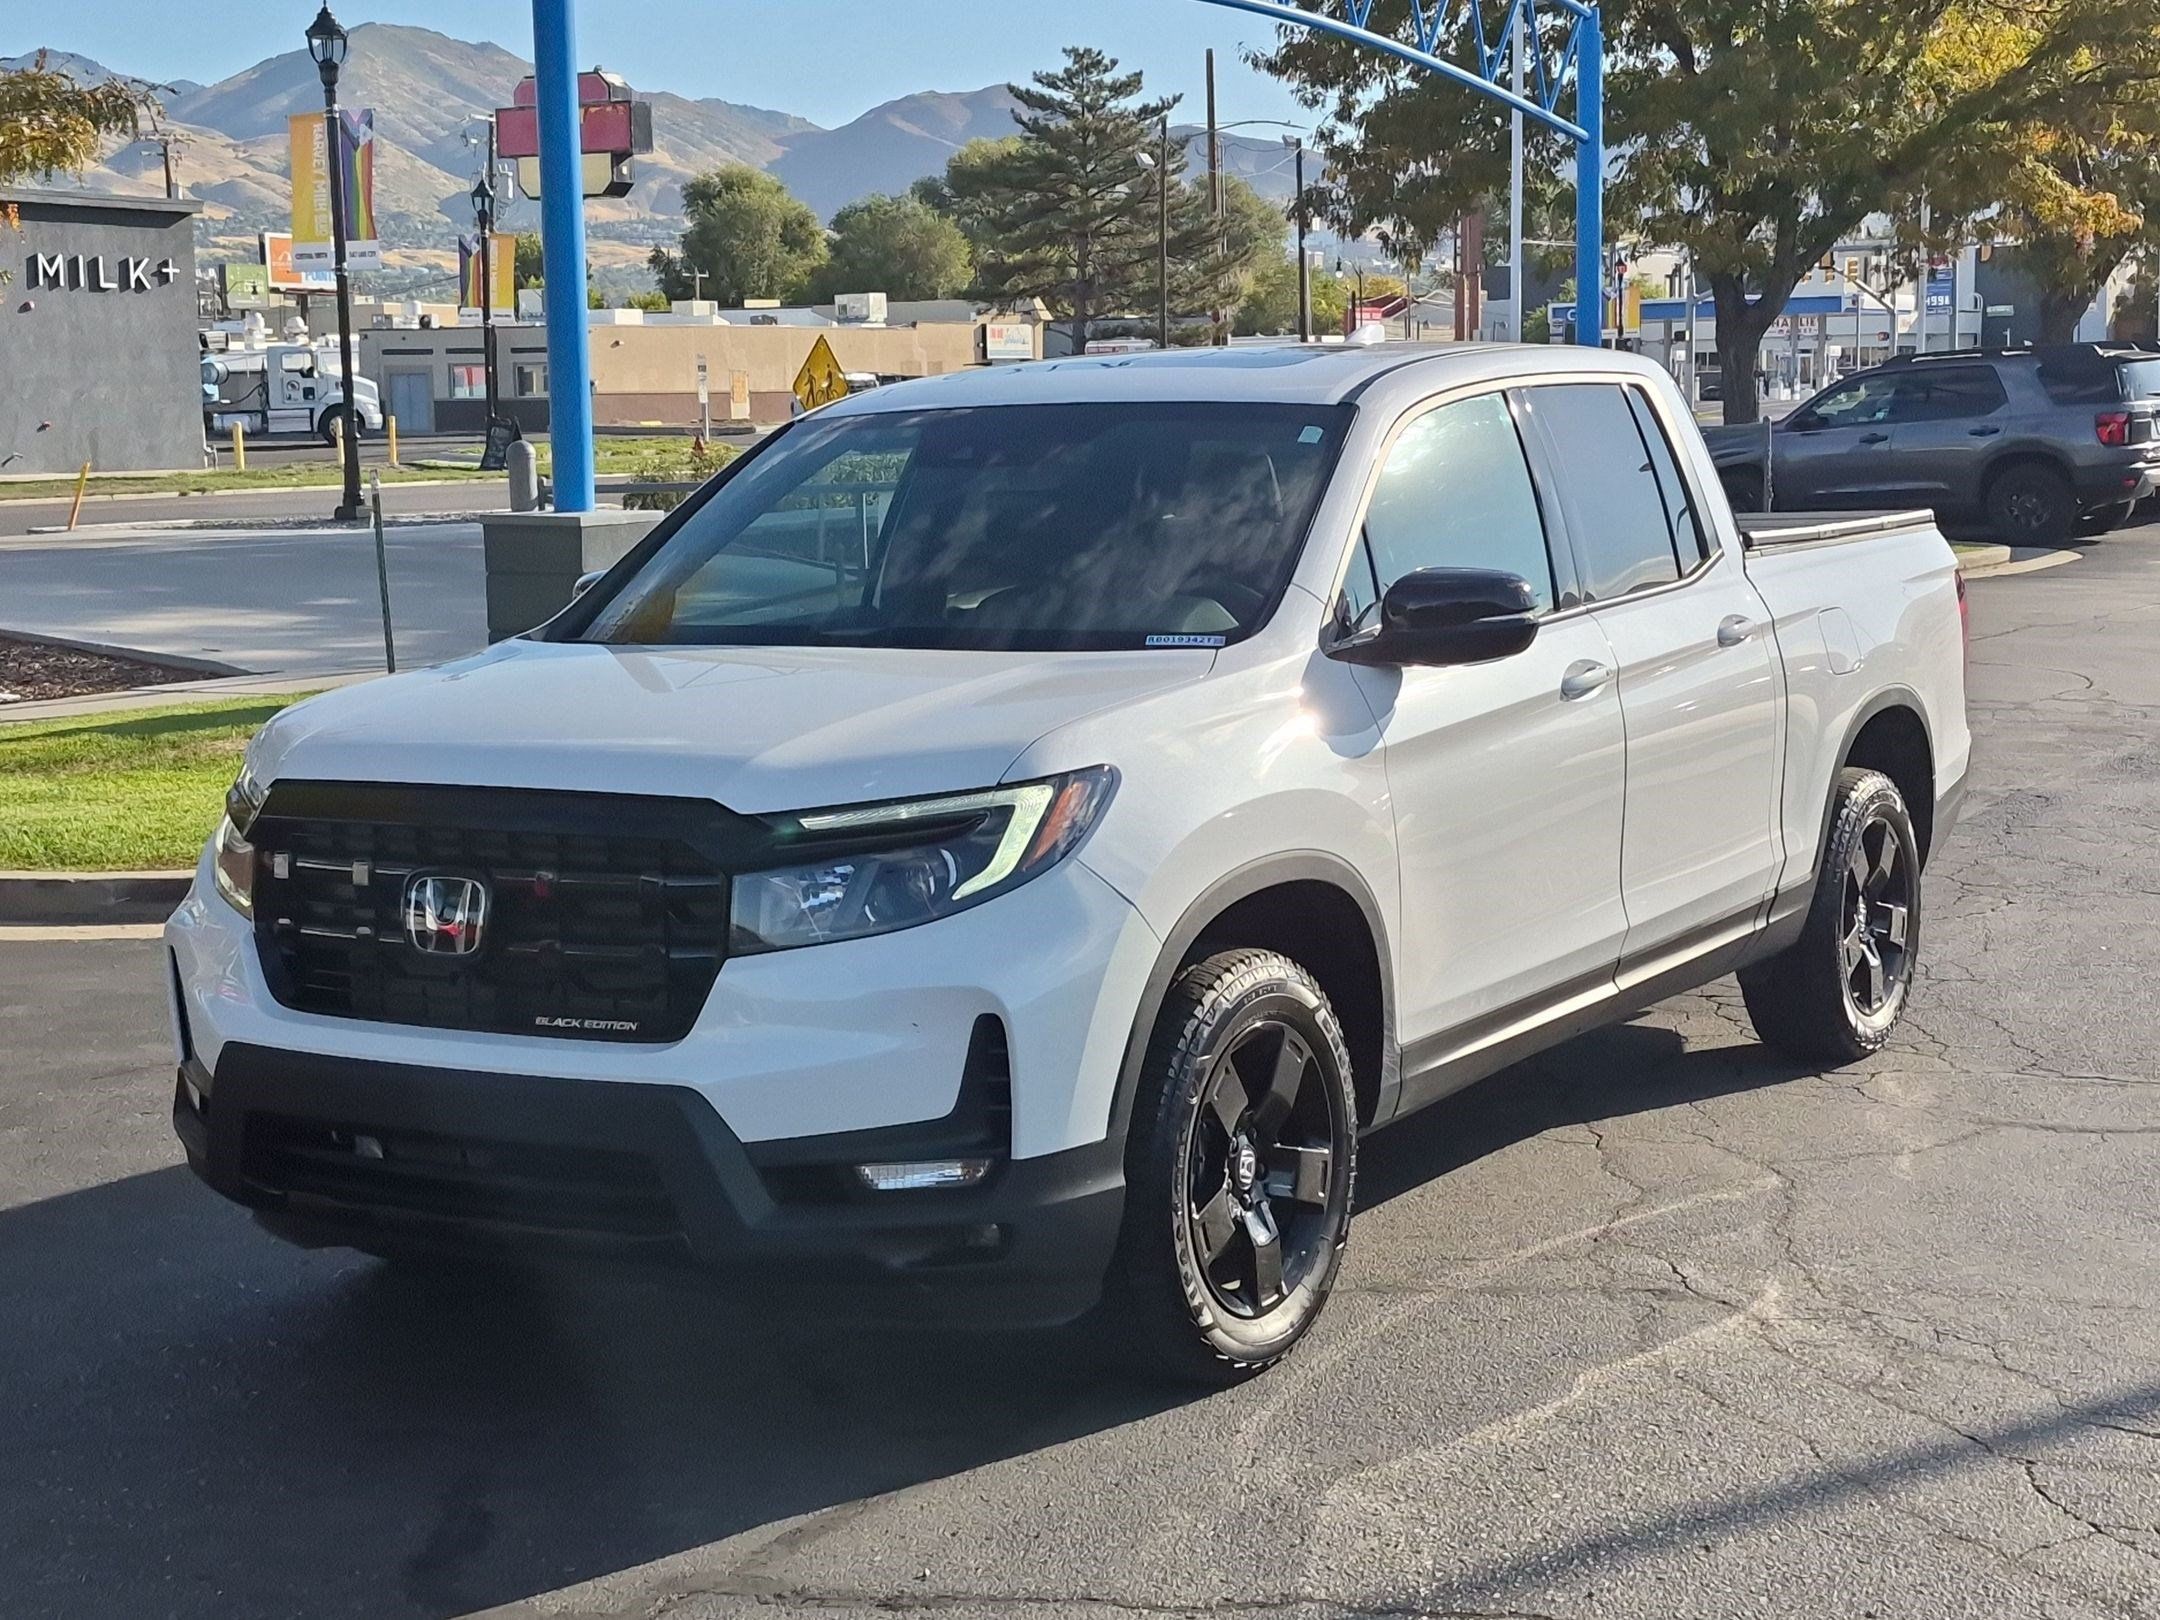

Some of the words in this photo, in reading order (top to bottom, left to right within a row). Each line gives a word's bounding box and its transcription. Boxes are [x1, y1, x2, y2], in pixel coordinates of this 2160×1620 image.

[37, 252, 181, 290] MILK+
[535, 1016, 582, 1028] BLACK
[583, 1019, 639, 1031] EDITION
